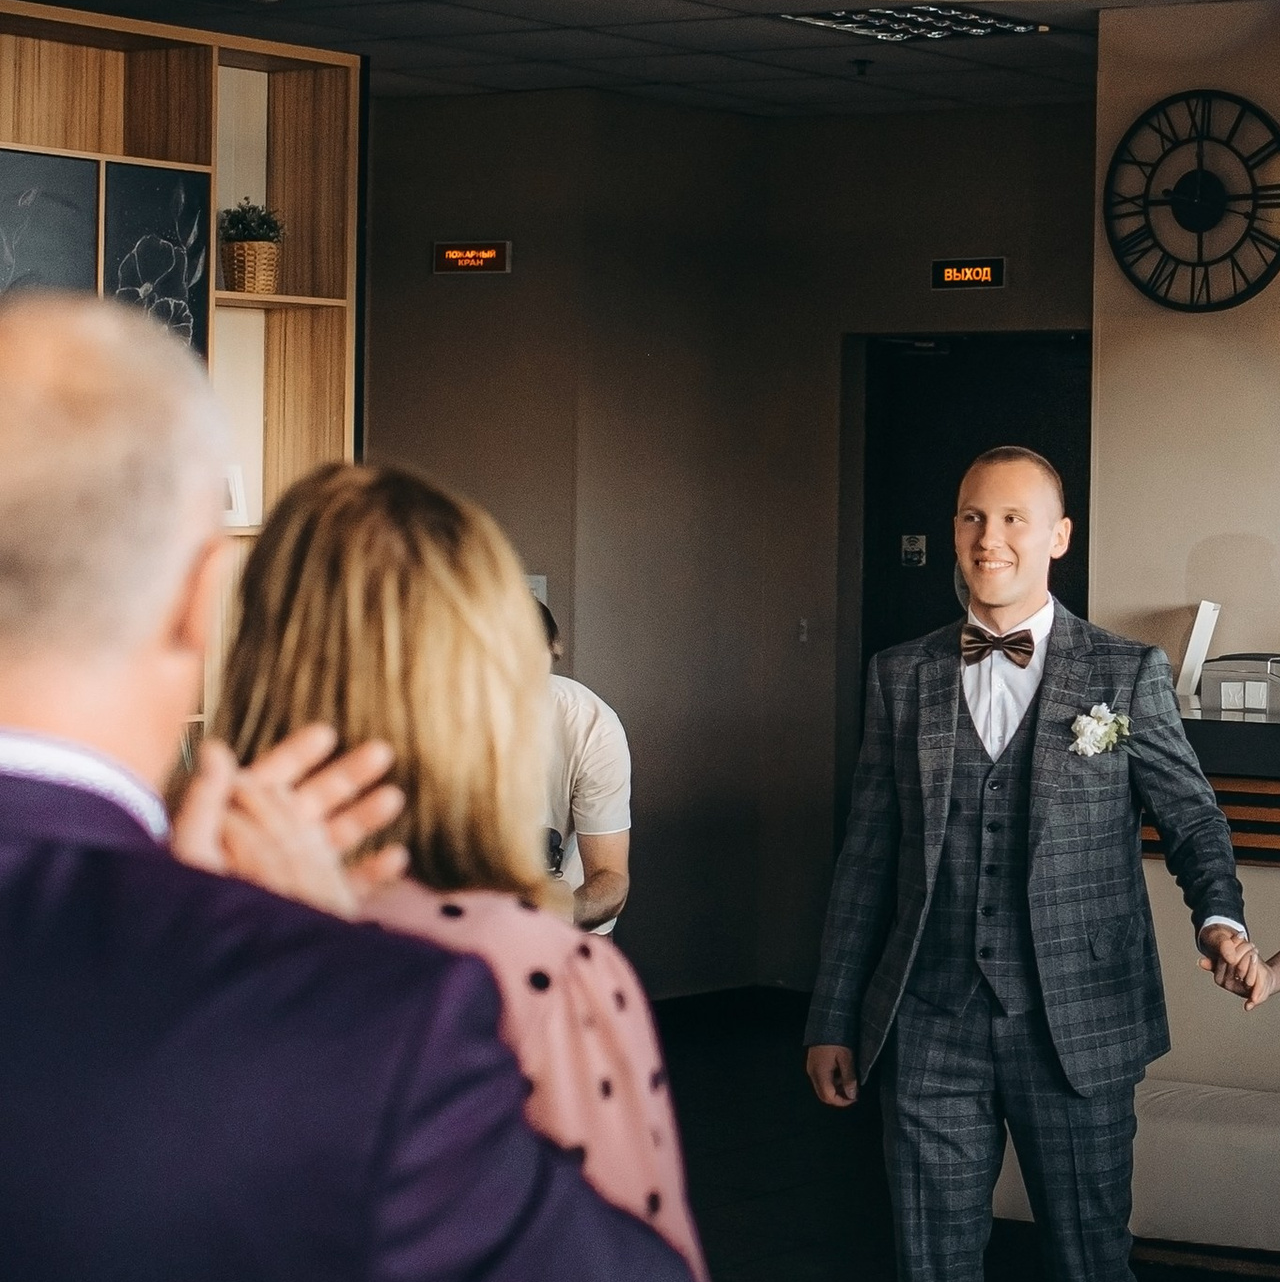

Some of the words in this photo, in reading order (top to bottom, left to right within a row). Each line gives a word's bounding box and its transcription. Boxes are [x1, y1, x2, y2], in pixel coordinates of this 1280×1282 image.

[445, 249, 496, 259] ПОЖАРНЫЙ
[458, 258, 484, 266] КРАН
[944, 266, 992, 282] ВЫХОД
